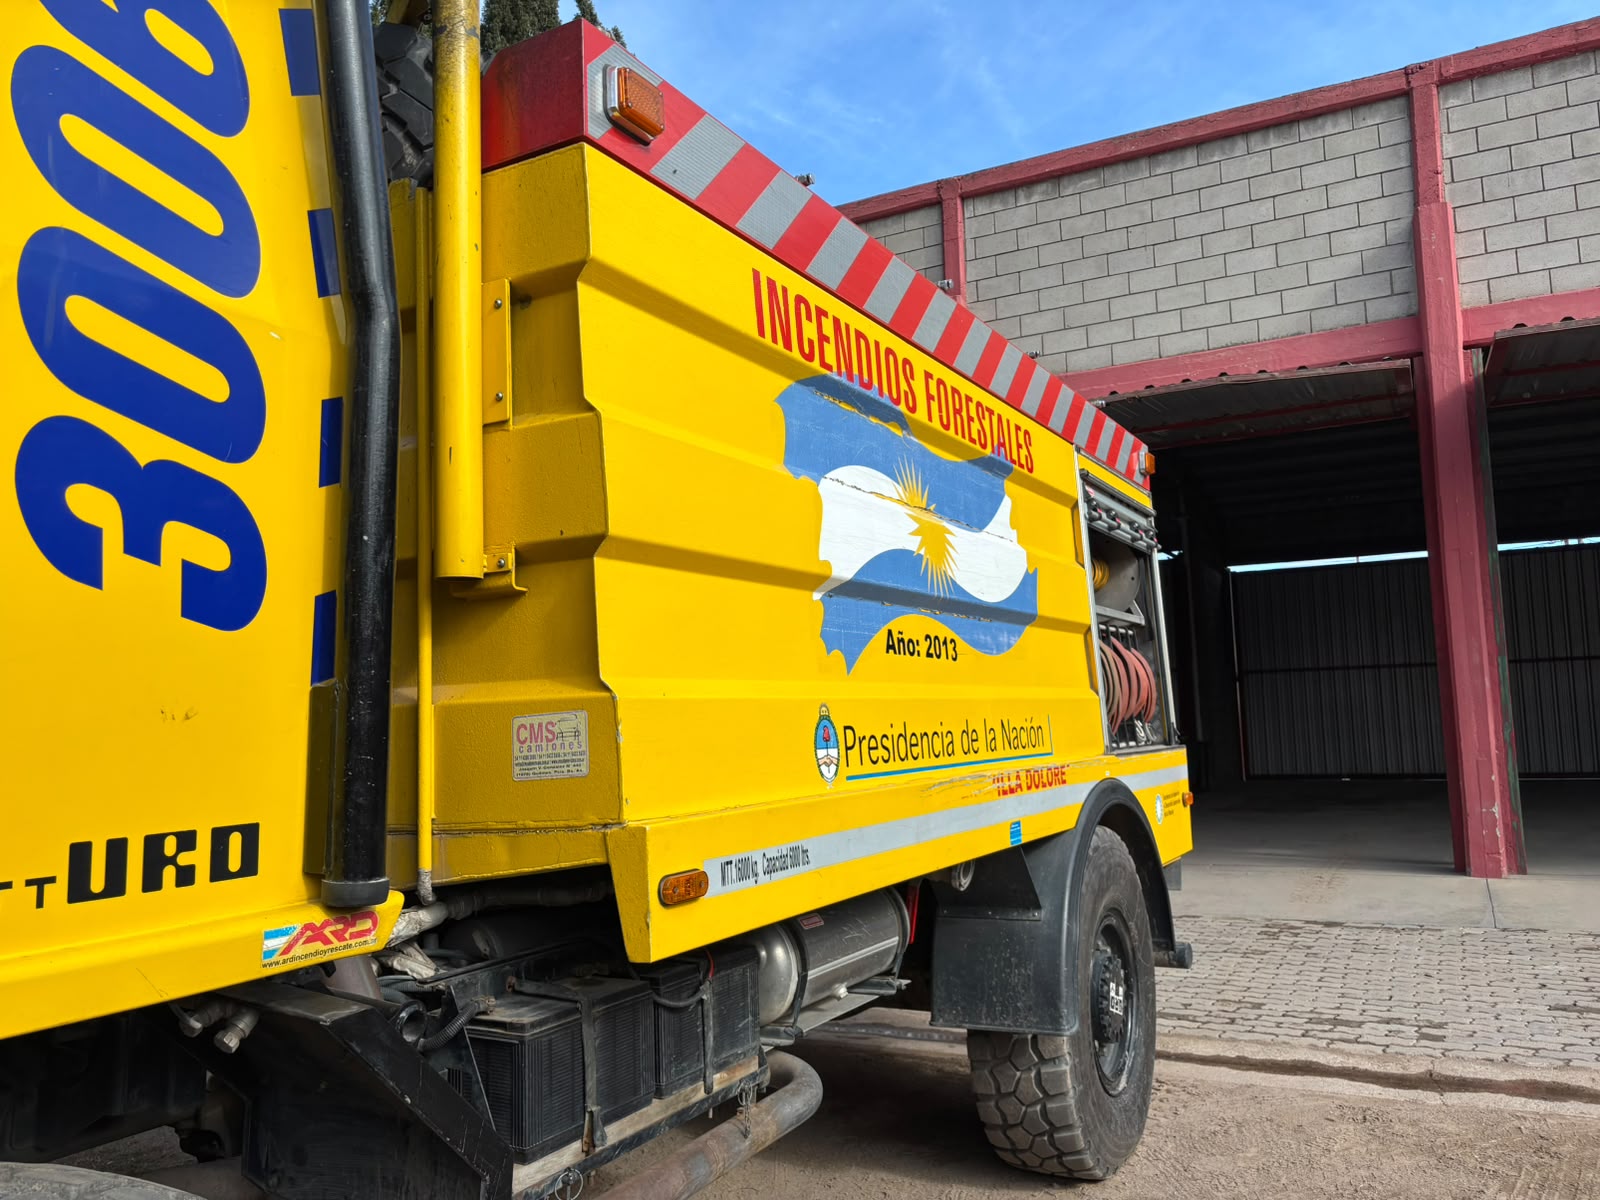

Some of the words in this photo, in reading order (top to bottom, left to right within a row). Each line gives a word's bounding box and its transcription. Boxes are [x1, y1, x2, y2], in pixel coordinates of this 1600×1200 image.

[752, 267, 917, 414] INCENDIOS
[923, 369, 1034, 474] FORESTALES
[885, 628, 921, 658] Año:
[924, 633, 958, 662] 2013
[516, 721, 556, 745] CMS
[519, 741, 583, 754] camiones
[843, 721, 955, 767] Presidencia
[960, 719, 980, 755] de
[983, 718, 997, 753] la
[1000, 717, 1045, 751] Nación
[1025, 764, 1070, 791] DOLORE
[762, 847, 789, 880] Capacidad
[789, 844, 801, 870] 6000
[279, 911, 379, 956] ARD
